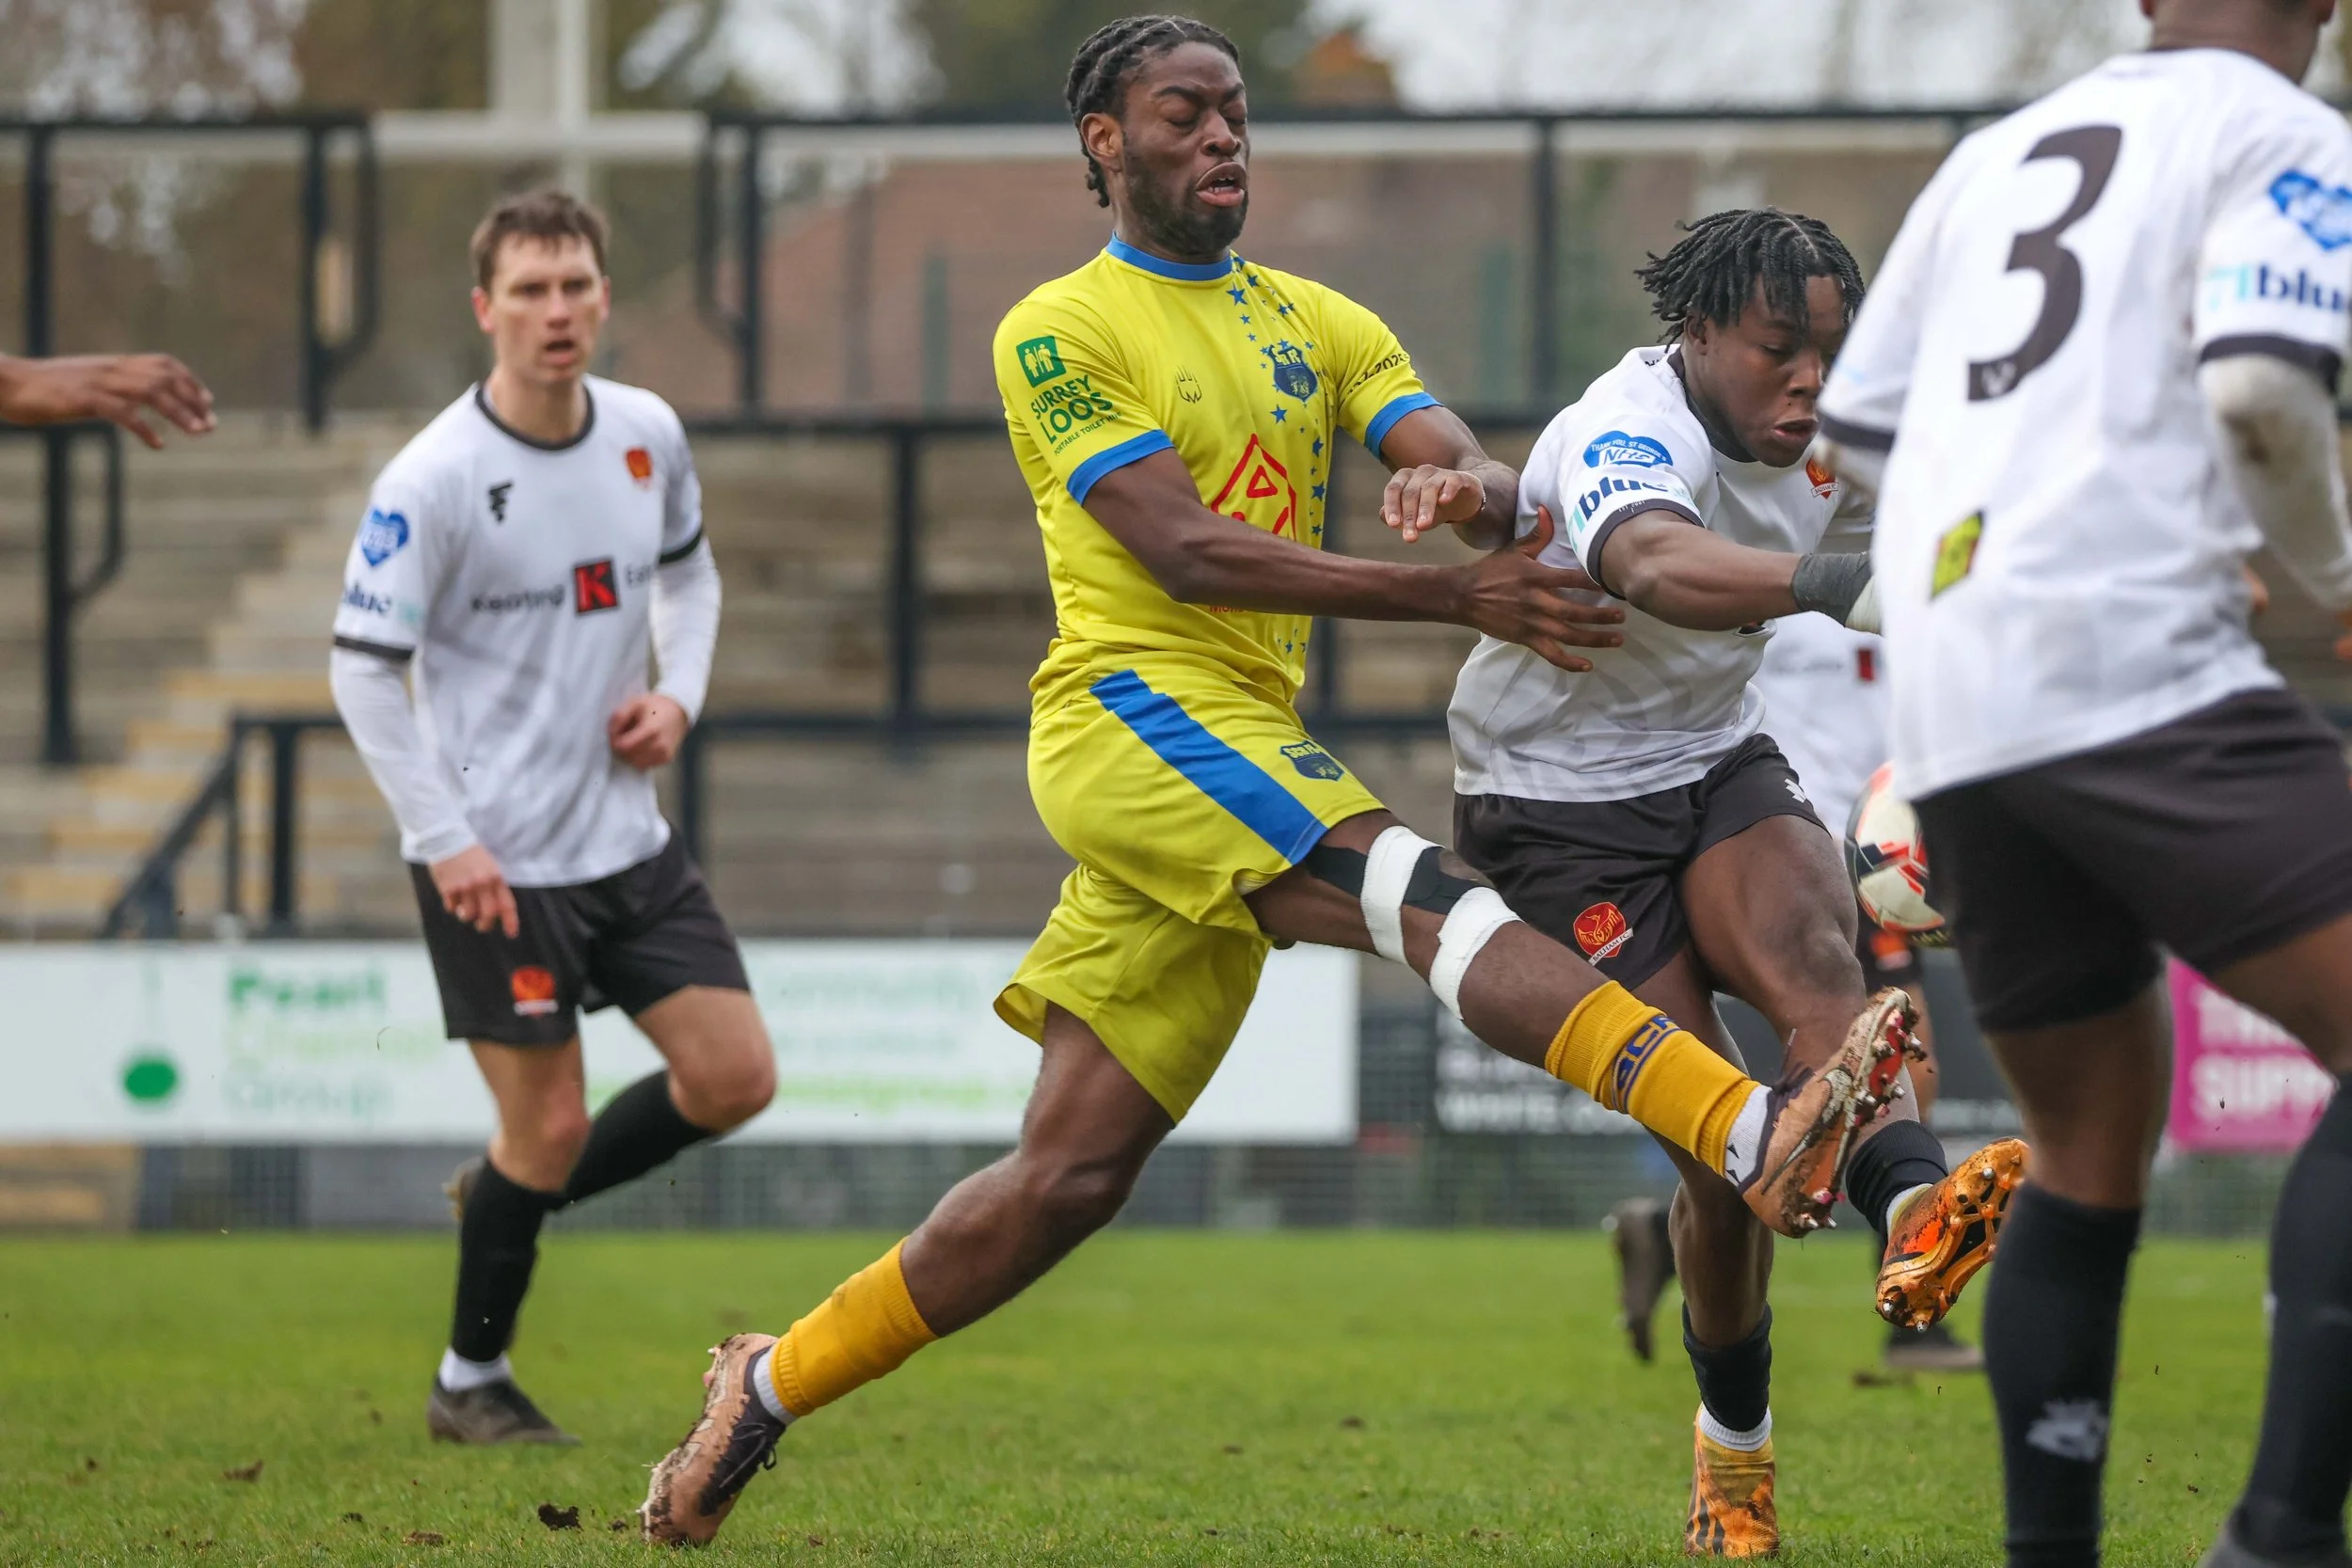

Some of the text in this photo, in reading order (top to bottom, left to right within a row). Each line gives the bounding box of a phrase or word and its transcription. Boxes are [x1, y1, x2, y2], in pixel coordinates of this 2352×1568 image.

[1967, 124, 2122, 403] 3
[1031, 374, 1091, 420] SURREY
[1041, 392, 1114, 444] LOOS
[1080, 417, 1105, 435] TOILET
[575, 562, 618, 611] K
[1593, 941, 1619, 961] BALHAM
